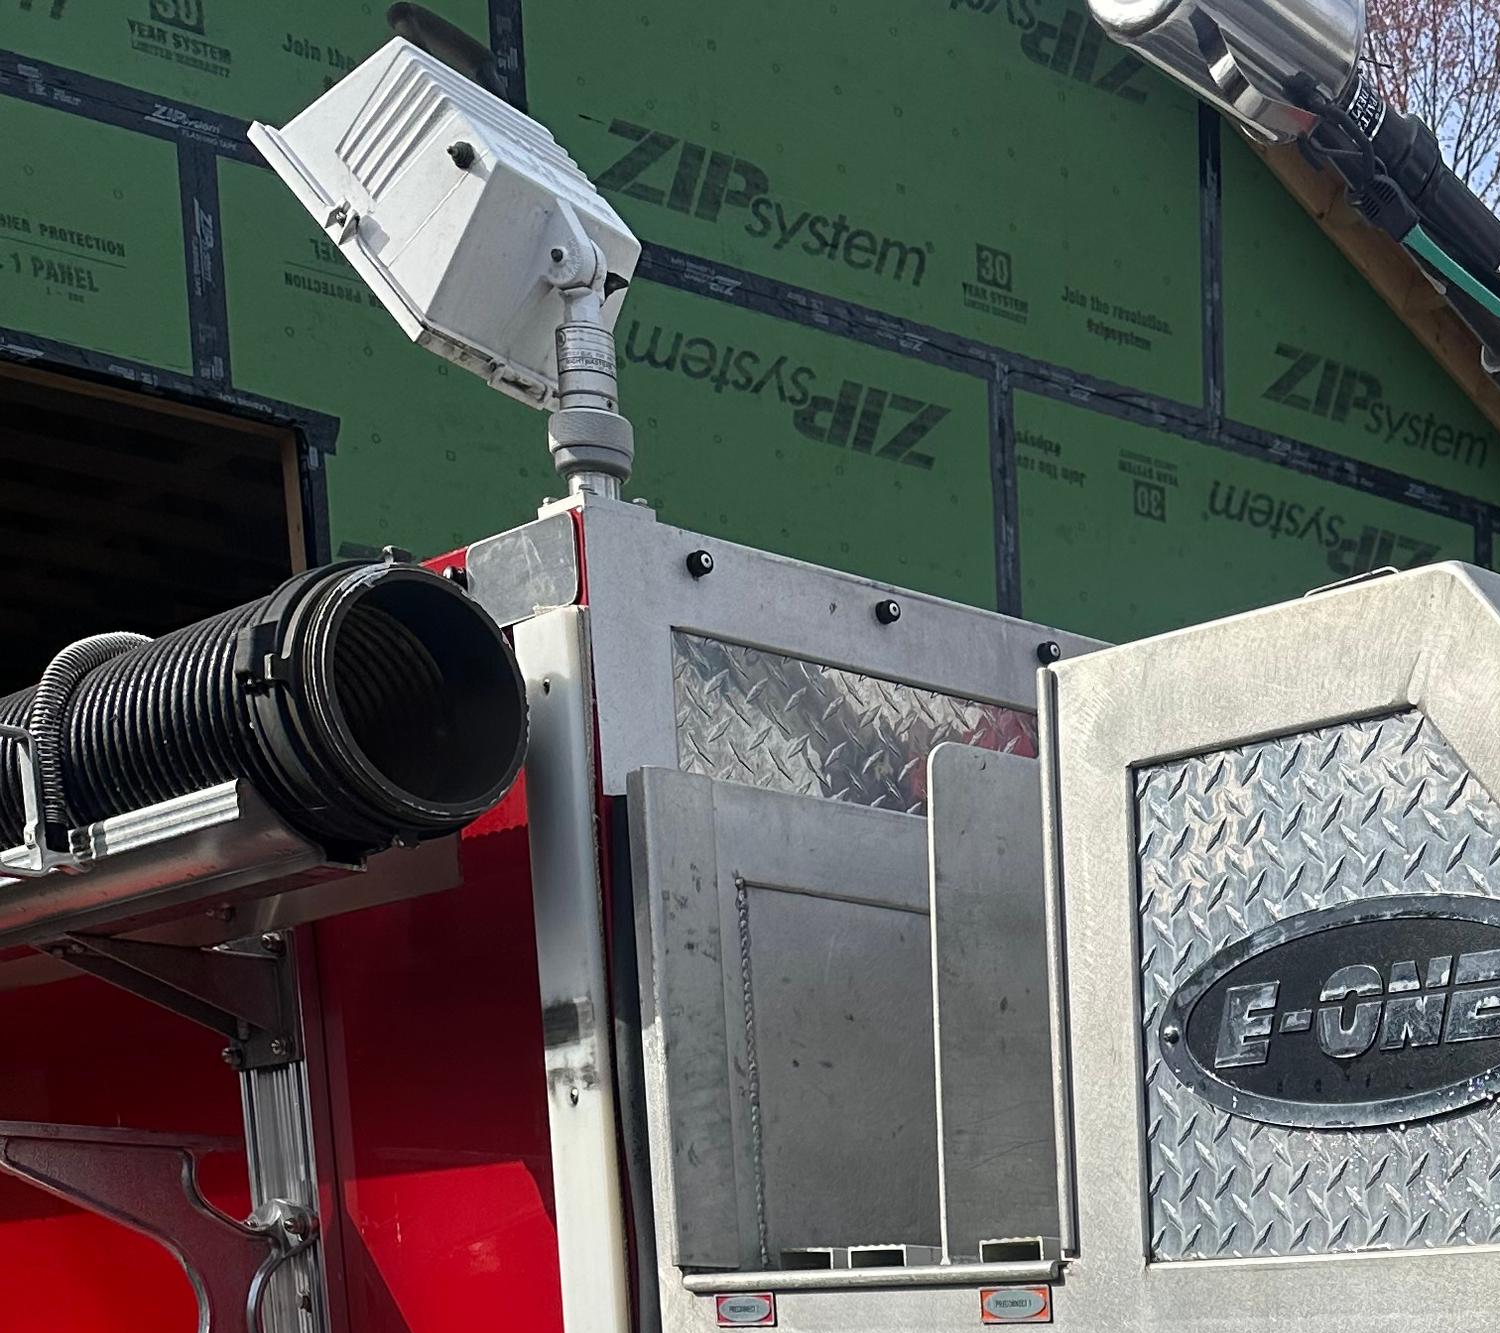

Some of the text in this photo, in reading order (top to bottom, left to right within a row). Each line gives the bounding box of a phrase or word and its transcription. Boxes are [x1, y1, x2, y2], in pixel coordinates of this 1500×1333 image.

[127, 19, 232, 65] YEAR SYSTEM
[281, 33, 321, 61] Join
[40, 222, 126, 258] PROTECTION
[32, 258, 100, 292] PANEL
[979, 249, 1010, 286] 30
[284, 271, 363, 304] PROTECTION
[1061, 285, 1087, 308] Join
[1091, 296, 1110, 315] the
